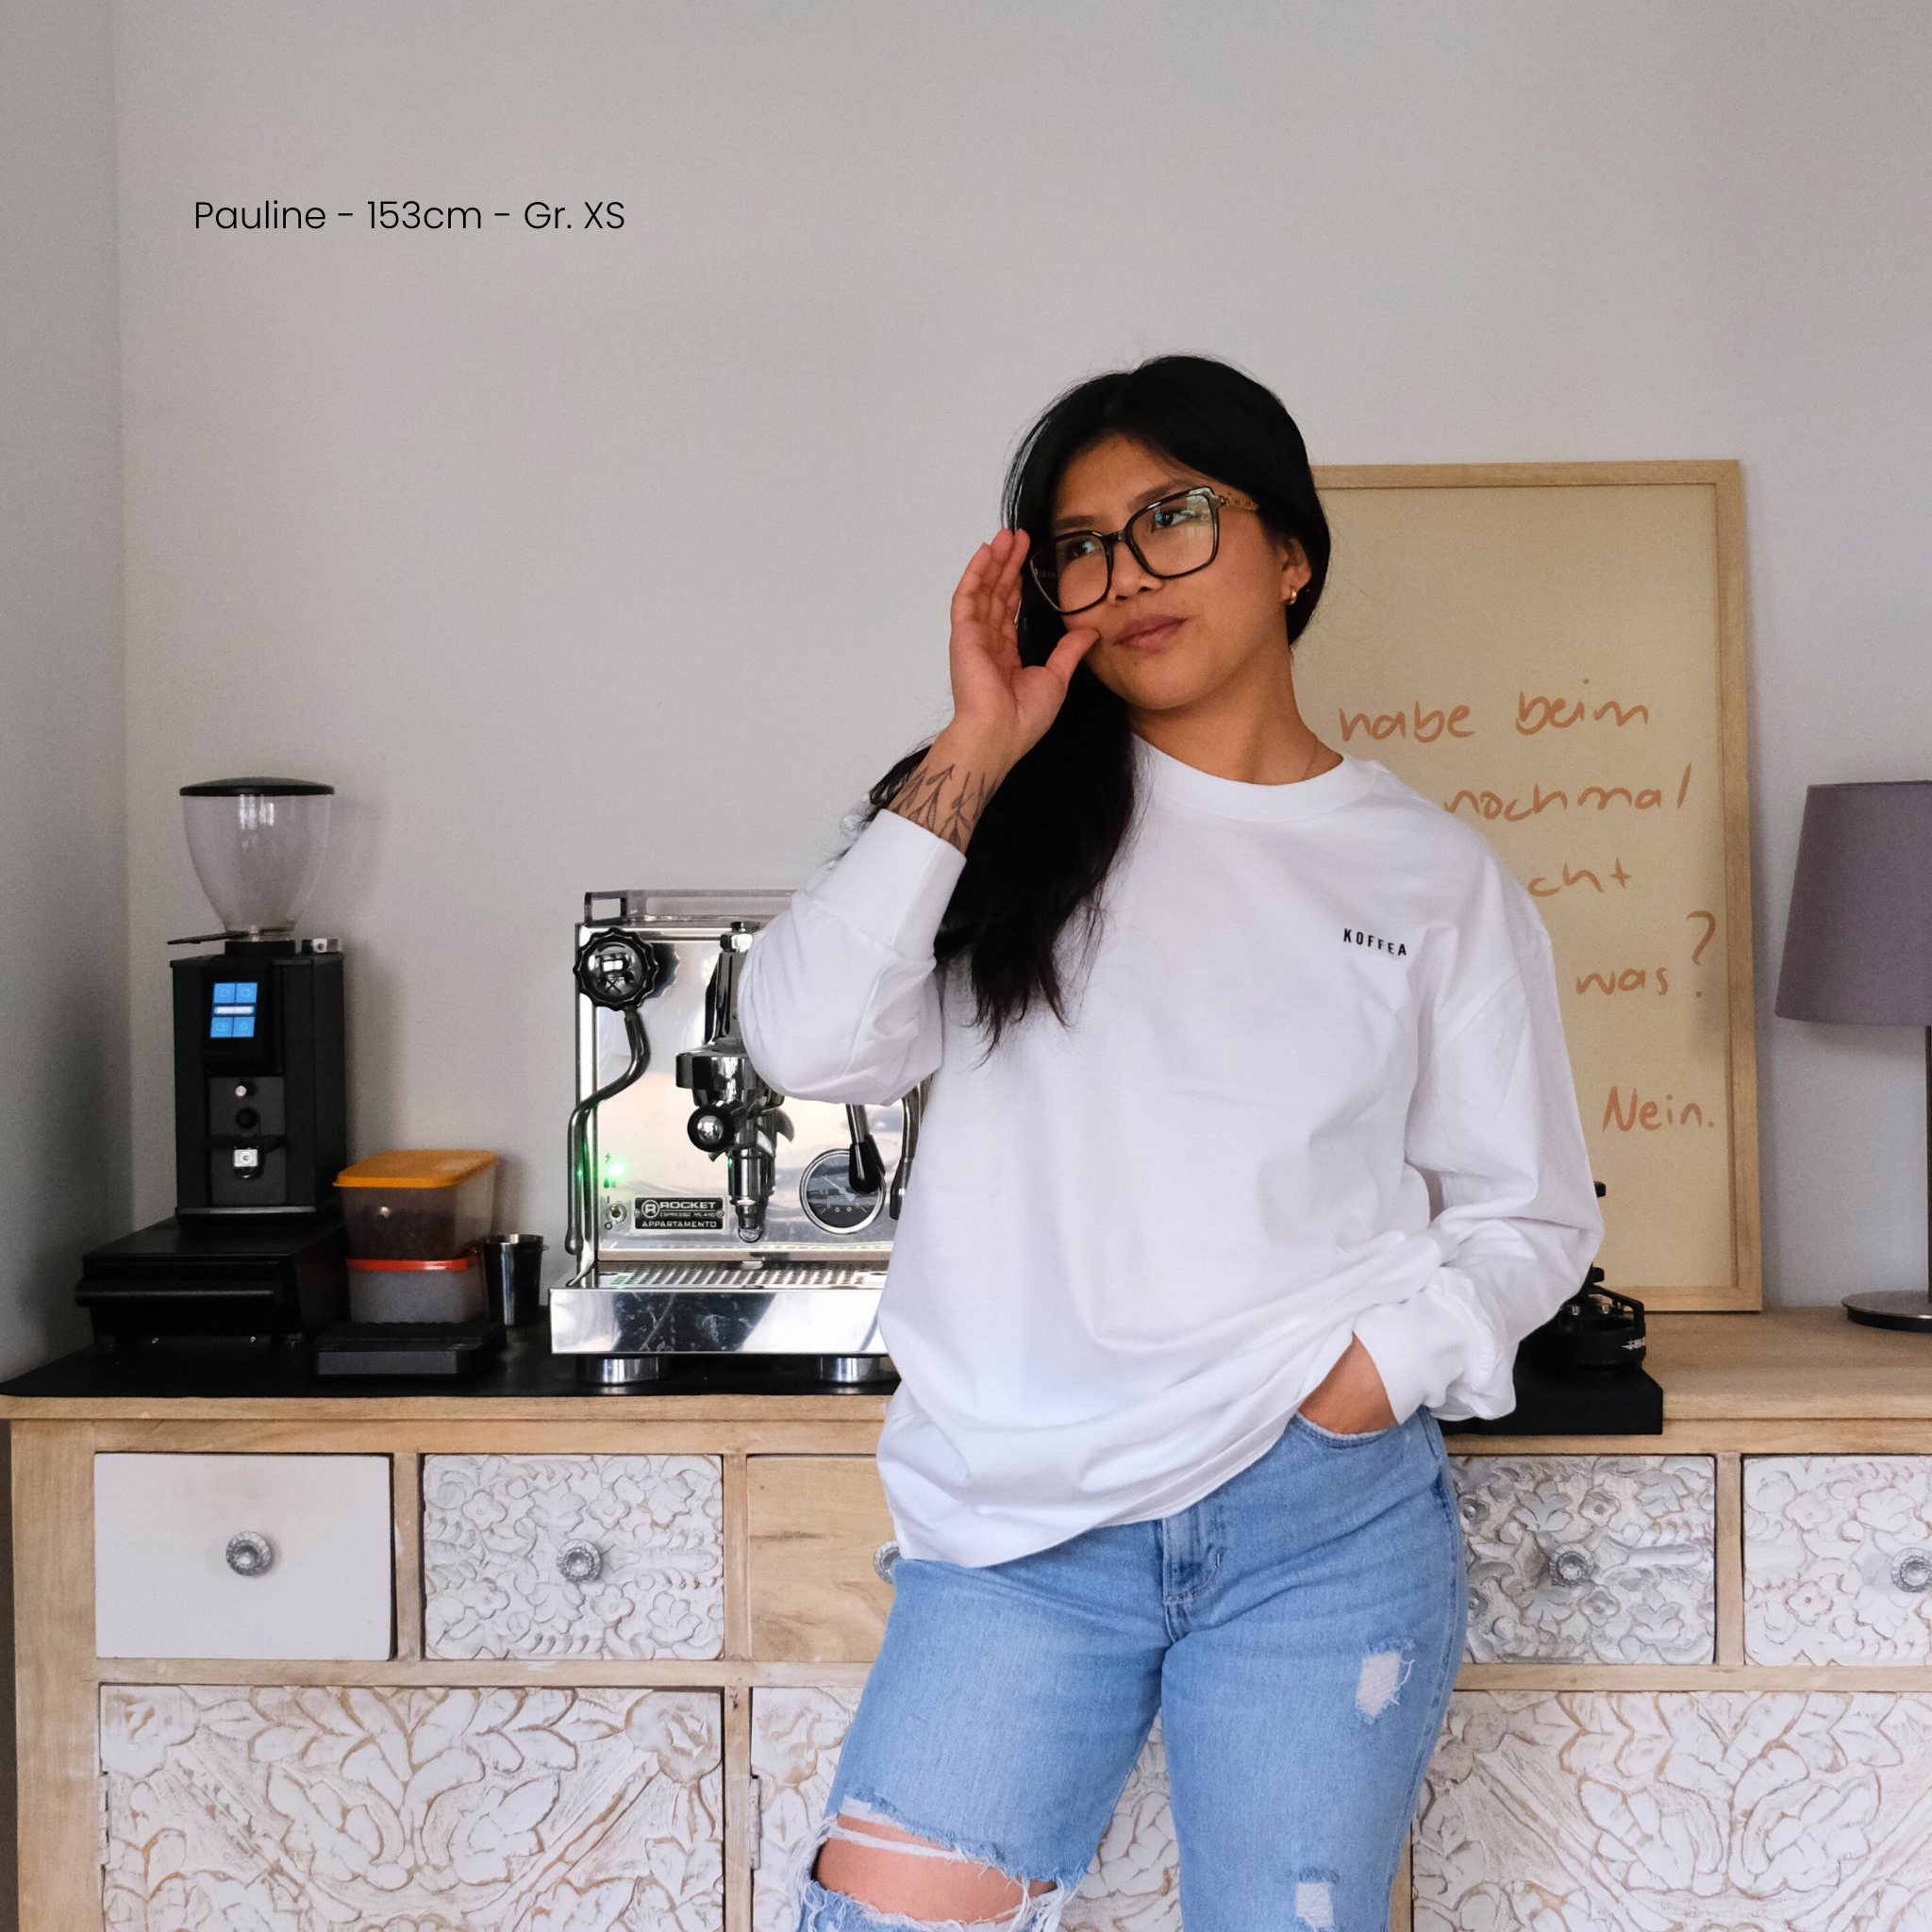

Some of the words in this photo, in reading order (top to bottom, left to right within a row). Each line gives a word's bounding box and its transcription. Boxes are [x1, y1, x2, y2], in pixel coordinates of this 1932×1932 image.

[1515, 677, 1649, 736] beim
[1442, 761, 1692, 823] nochmal
[1342, 927, 1407, 957] KOFFEA
[1602, 1086, 1715, 1132] Nein.
[659, 1201, 717, 1209] ROCKET
